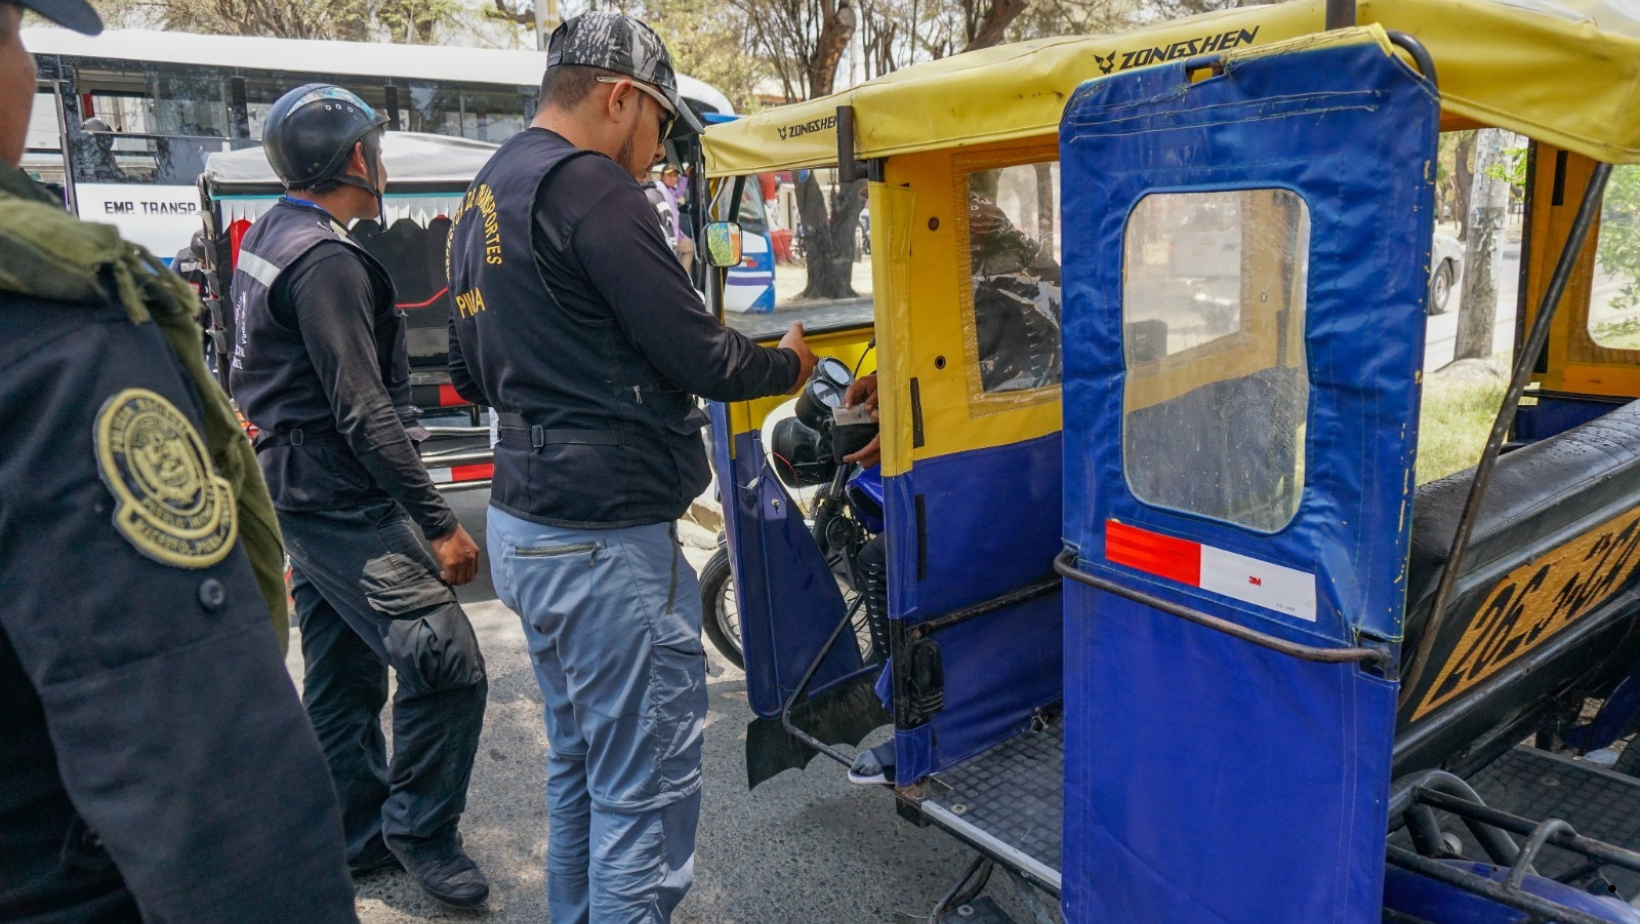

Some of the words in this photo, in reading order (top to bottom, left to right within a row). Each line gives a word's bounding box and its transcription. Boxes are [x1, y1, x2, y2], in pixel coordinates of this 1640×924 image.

[1118, 25, 1260, 70] ZONGSHEN
[104, 201, 136, 215] EMP.
[140, 202, 197, 215] TRANSP
[1248, 575, 1262, 587] 3M
